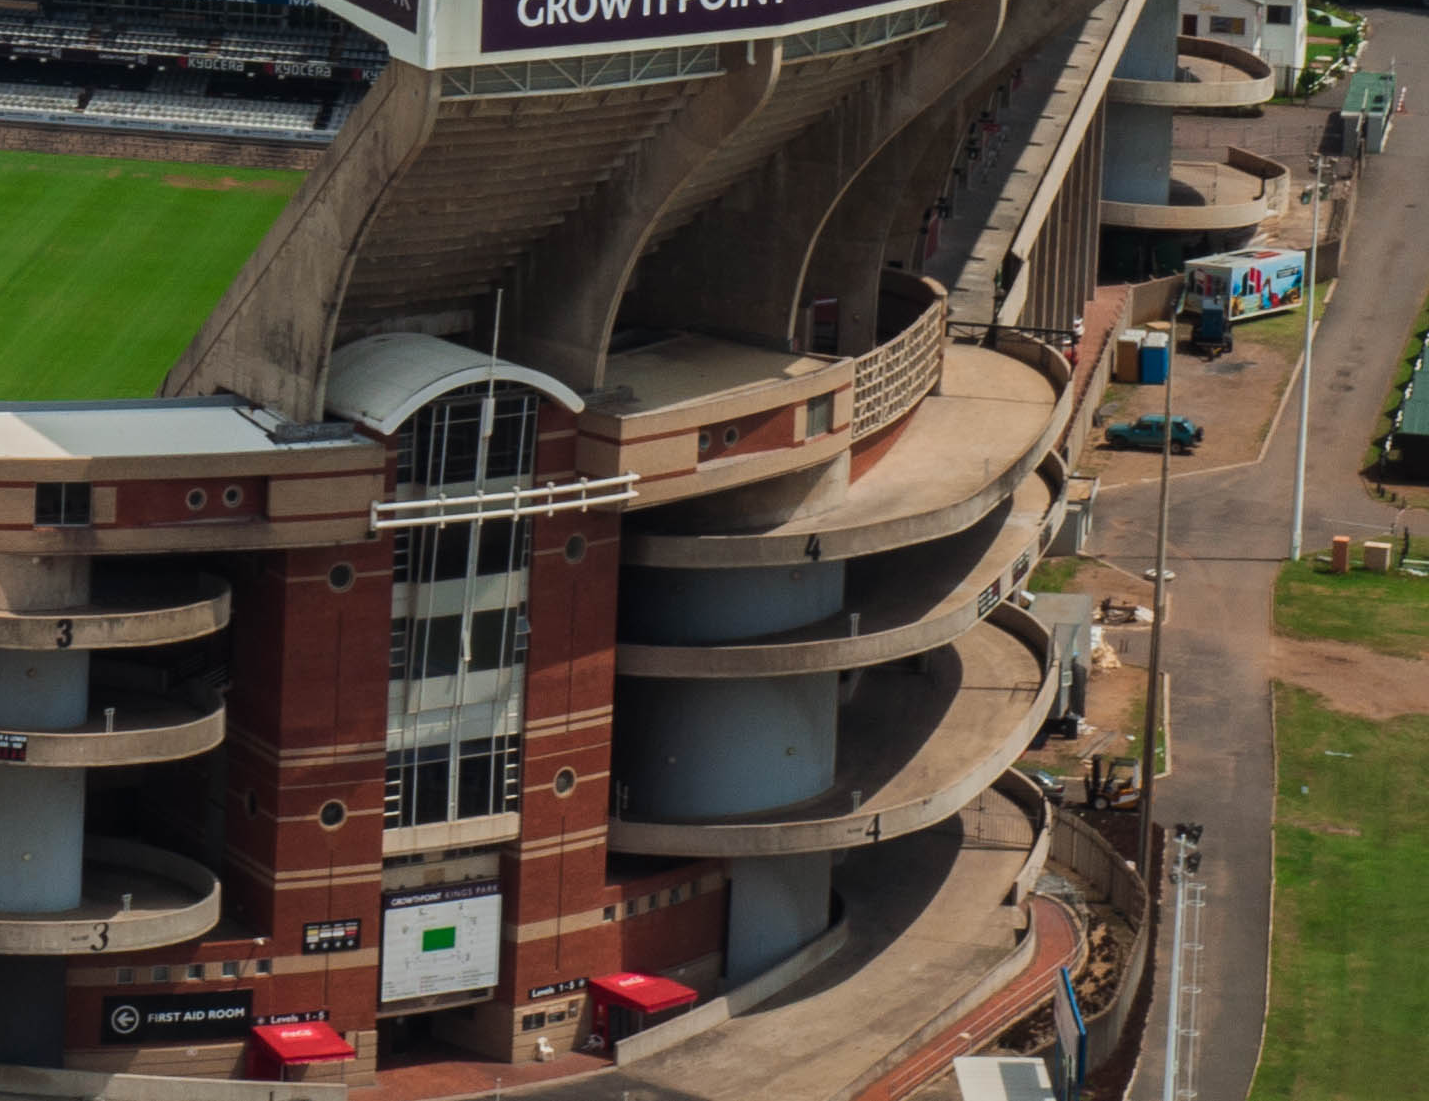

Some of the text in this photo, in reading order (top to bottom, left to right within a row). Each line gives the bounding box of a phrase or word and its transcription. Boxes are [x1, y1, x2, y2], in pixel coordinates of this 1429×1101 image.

[805, 533, 821, 561] 4
[56, 619, 73, 648] 3
[865, 813, 881, 841] 4
[91, 922, 109, 951] 3
[147, 1008, 245, 1024] FIRST AID ROOM
[270, 1015, 299, 1024] Levels
